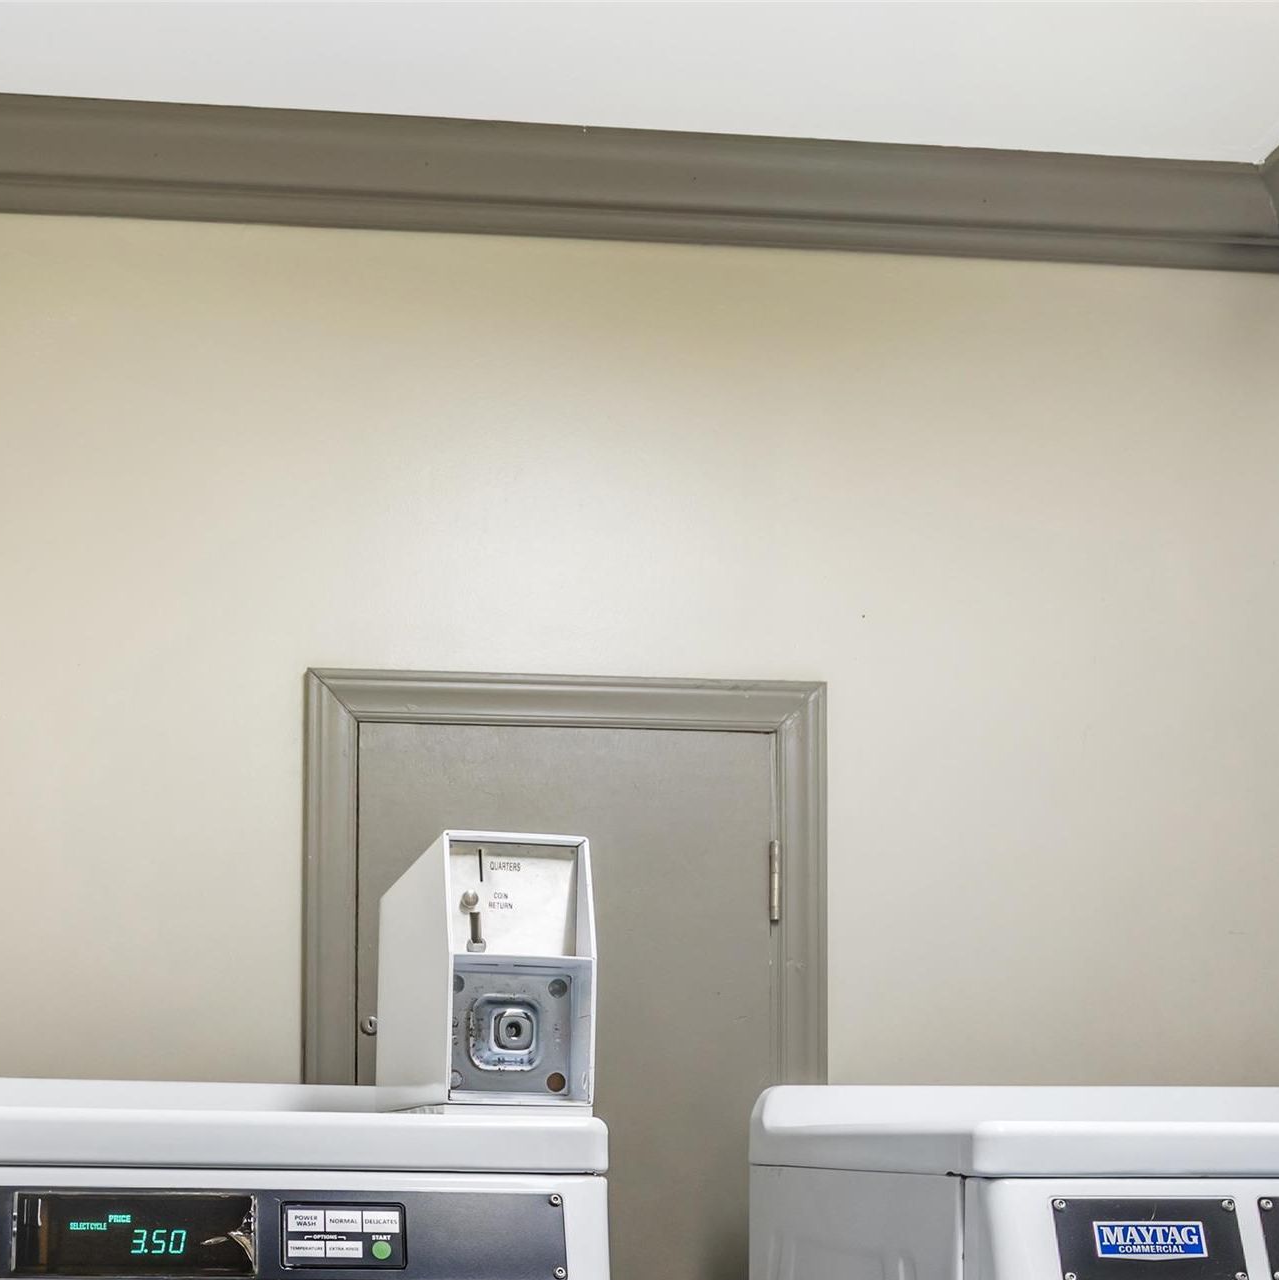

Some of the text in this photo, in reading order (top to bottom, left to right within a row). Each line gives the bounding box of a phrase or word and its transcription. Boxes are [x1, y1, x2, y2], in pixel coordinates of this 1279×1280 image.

[490, 861, 520, 871] QUARTERS
[108, 1214, 131, 1223] PRICE
[69, 1222, 89, 1230] SELECT
[1100, 1226, 1199, 1246] MAYTAG
[130, 1229, 187, 1254] 3.50
[1118, 1245, 1185, 1253] COMMERCIAL
